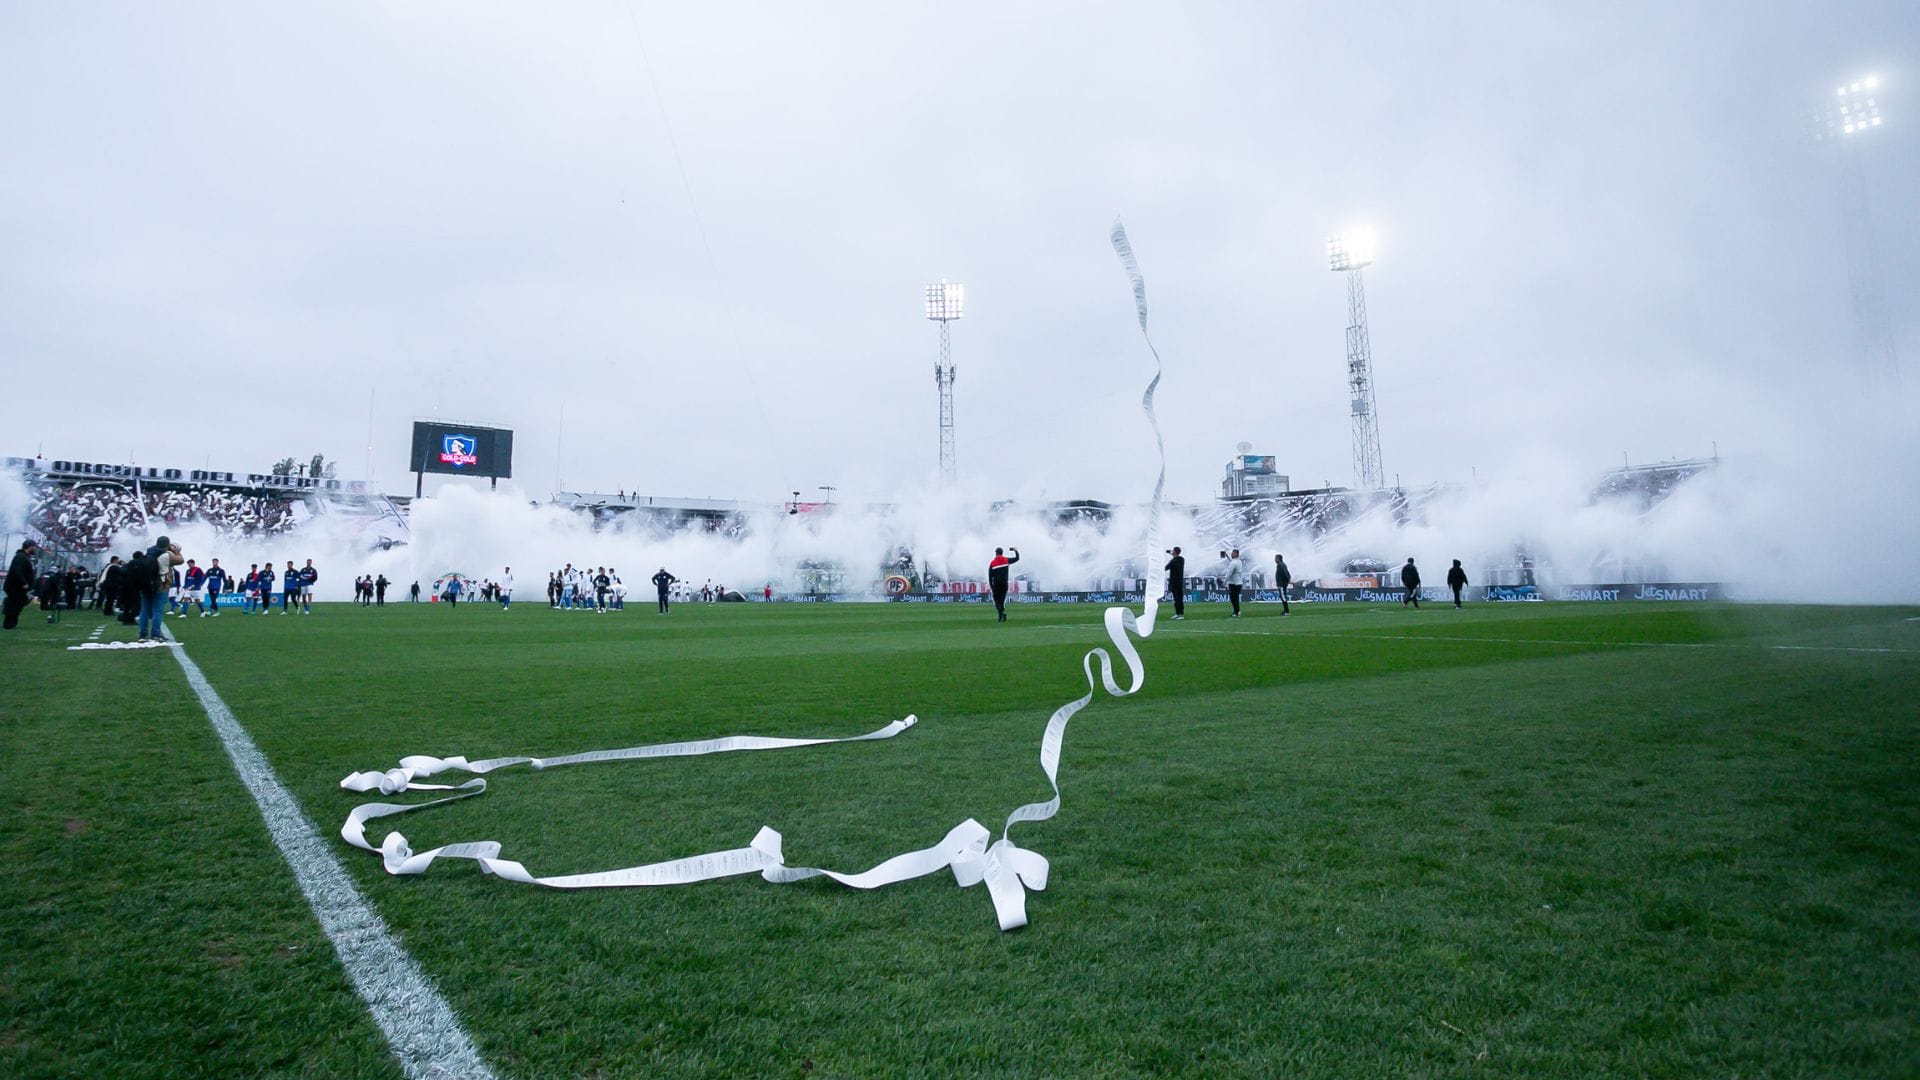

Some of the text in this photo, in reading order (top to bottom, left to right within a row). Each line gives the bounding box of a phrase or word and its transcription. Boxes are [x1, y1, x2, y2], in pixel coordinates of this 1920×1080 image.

[52, 460, 184, 481] ORGULLO
[191, 470, 239, 484] DEL
[889, 580, 903, 592] PF
[1634, 584, 1708, 601] JetSMART
[1300, 588, 1346, 603] JetSMART
[1355, 587, 1406, 603] JetSMART
